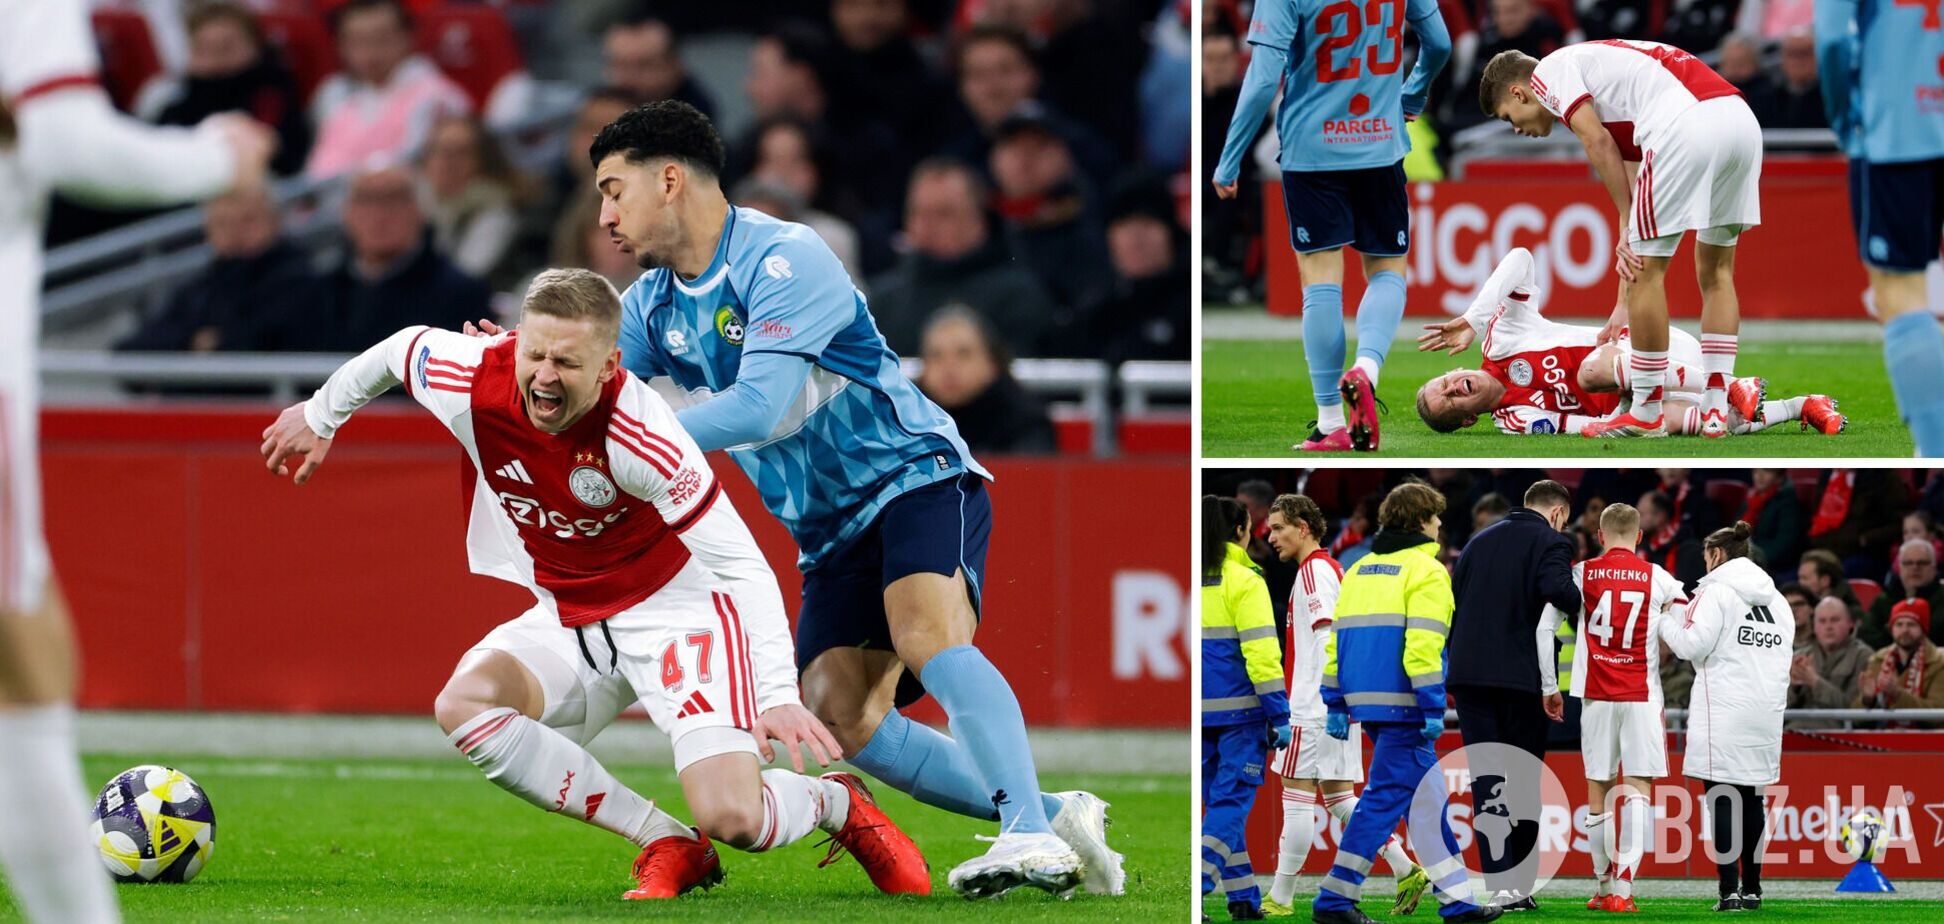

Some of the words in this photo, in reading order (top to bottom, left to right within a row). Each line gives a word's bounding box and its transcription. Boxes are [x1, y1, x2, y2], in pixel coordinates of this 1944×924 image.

[1315, 0, 1402, 83] 23
[1323, 118, 1392, 134] PARCEL
[1323, 134, 1393, 144] INTERNATIONAL
[667, 467, 698, 498] ROCK
[1587, 568, 1648, 582] ZINCHENKO
[1111, 570, 1191, 680] R
[1588, 590, 1645, 649] 47
[1737, 625, 1782, 648] Ziggo
[660, 630, 714, 693] 47
[1592, 653, 1634, 664] OLYMPIA
